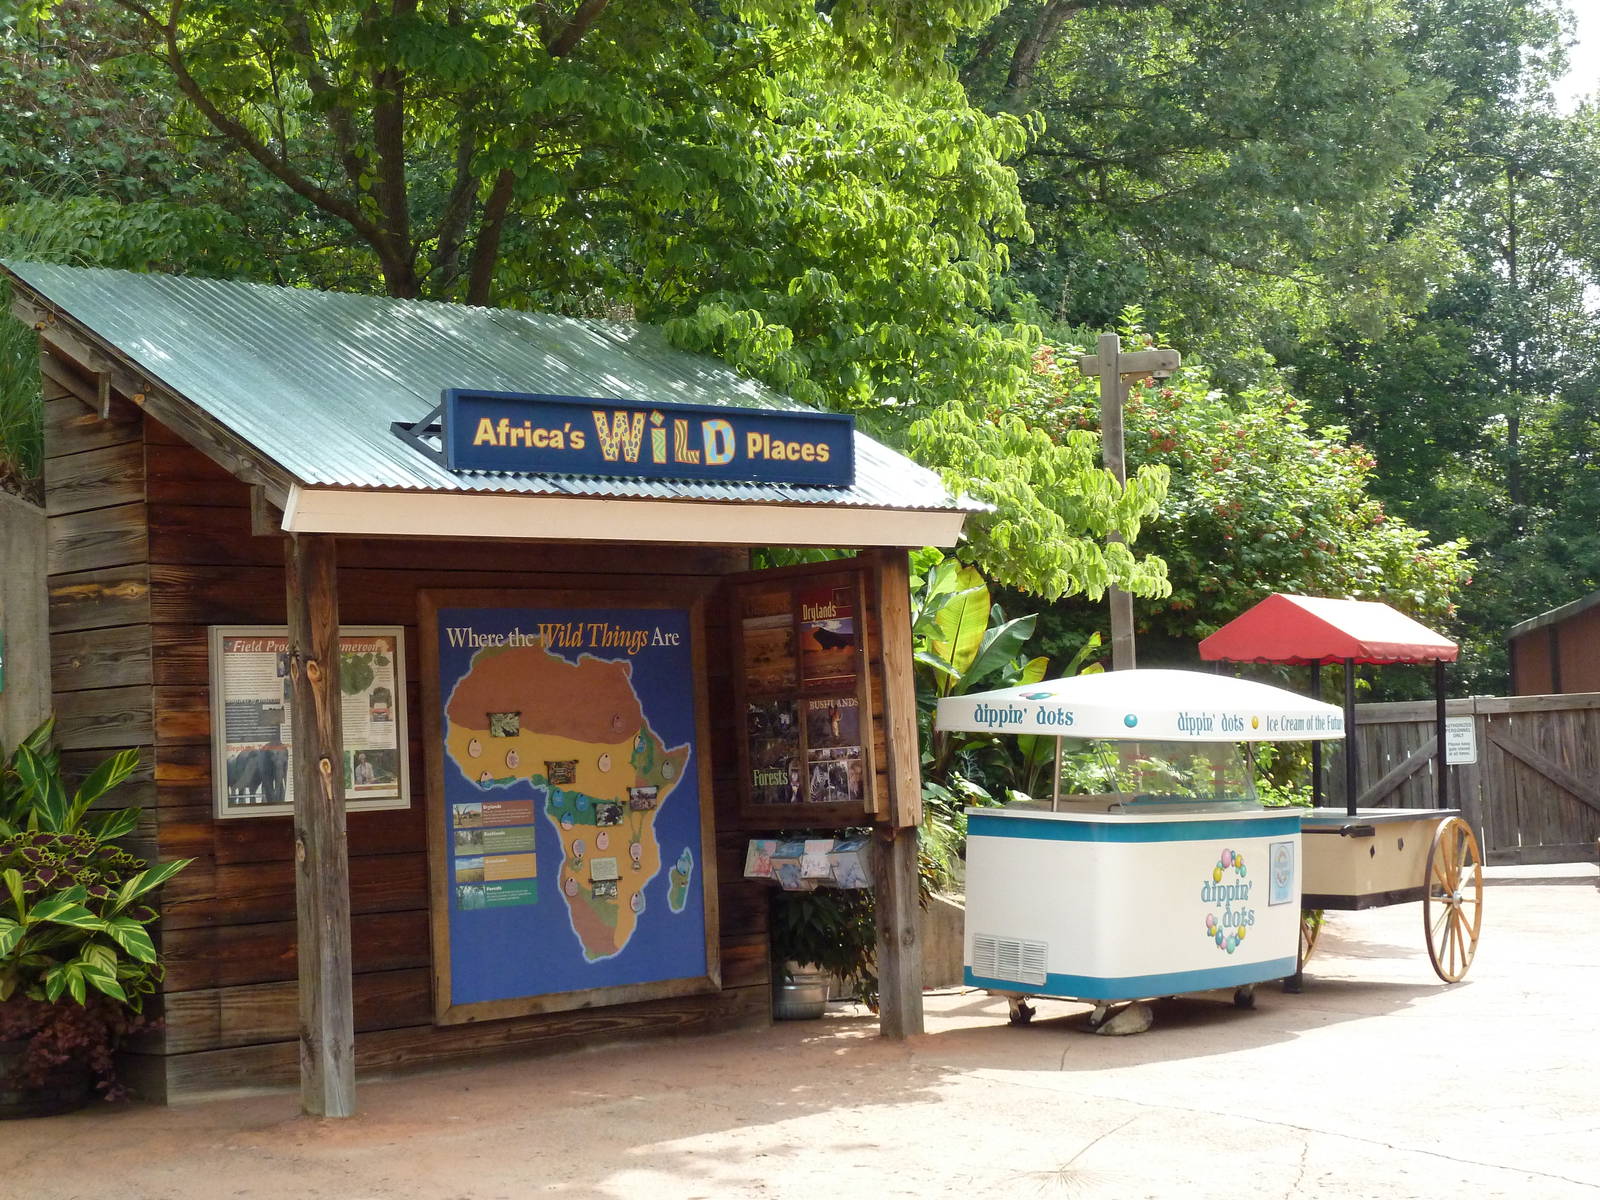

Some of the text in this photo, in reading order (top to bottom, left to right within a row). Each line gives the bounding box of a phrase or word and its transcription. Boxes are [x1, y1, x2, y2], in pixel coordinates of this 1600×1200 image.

[473, 416, 585, 450] Africa's
[746, 431, 831, 464] Places
[802, 601, 838, 621] Drylands
[233, 639, 263, 652] Field
[445, 622, 681, 656] Where the Wild Things Are
[974, 703, 1075, 728] dippin' dots
[1177, 711, 1245, 736] dippin' dots
[1266, 715, 1279, 732] Ice
[1280, 714, 1305, 732] Cream
[1306, 714, 1314, 731] of
[1315, 714, 1326, 731] the
[752, 769, 789, 787] Forests
[1200, 879, 1253, 908] dippin'
[1222, 906, 1256, 928] dots
